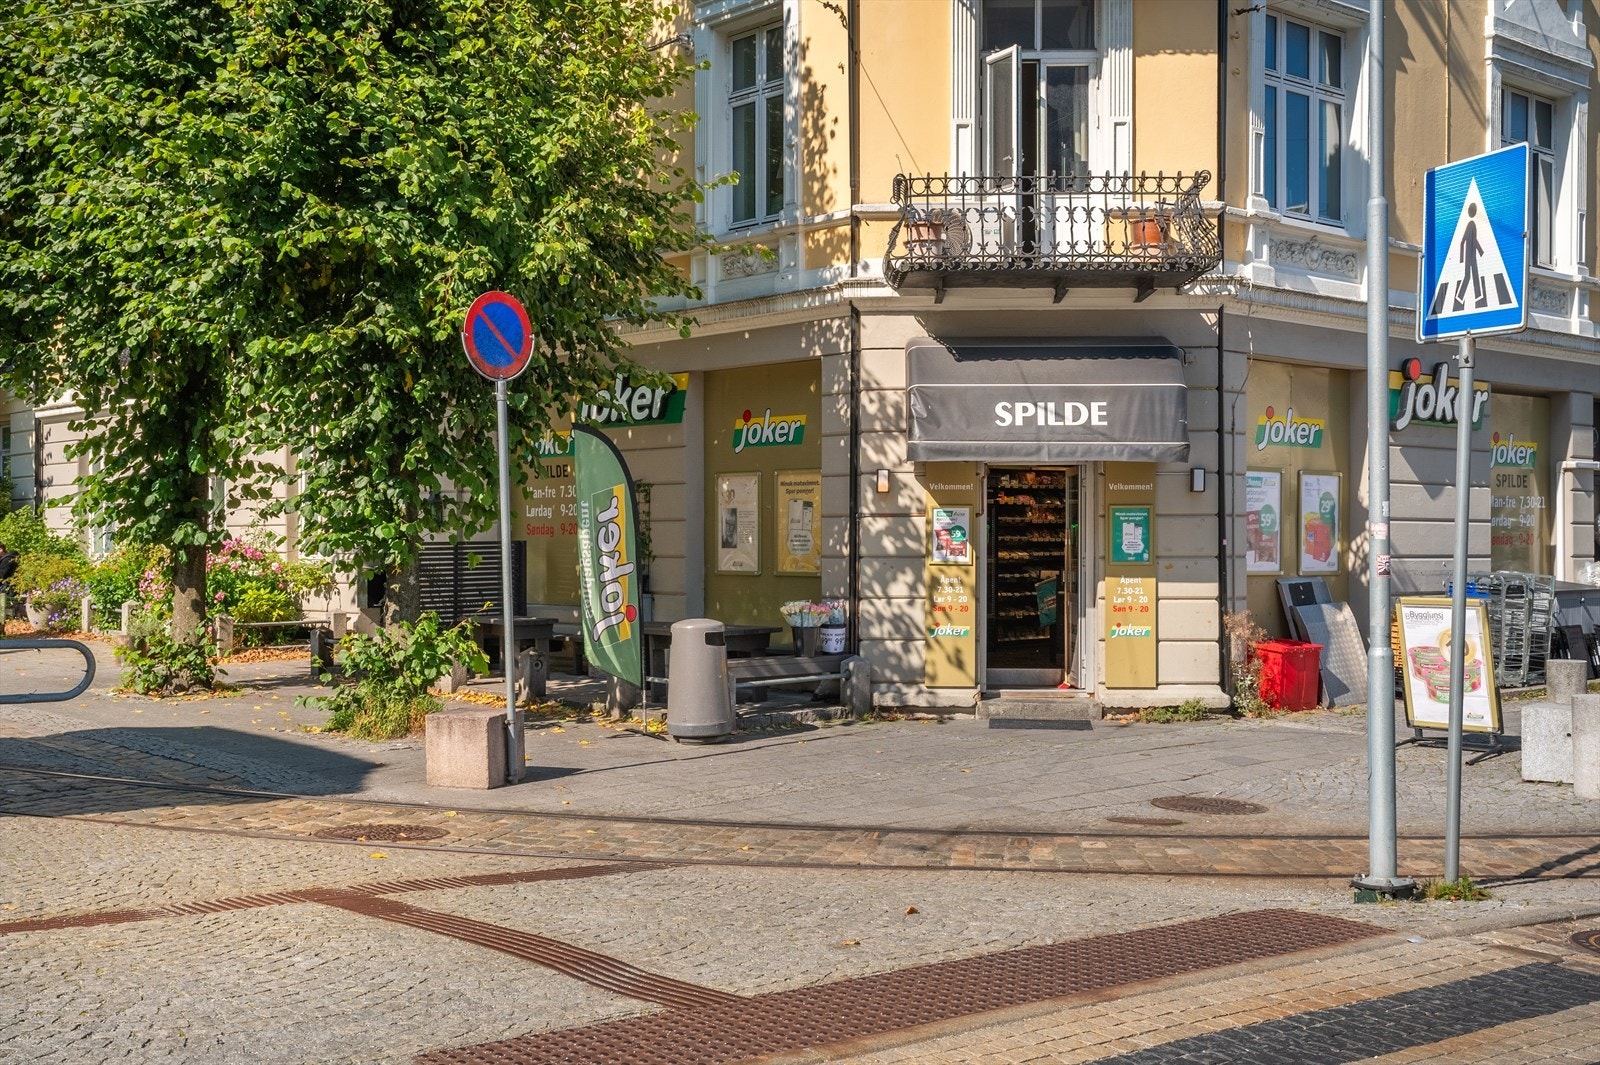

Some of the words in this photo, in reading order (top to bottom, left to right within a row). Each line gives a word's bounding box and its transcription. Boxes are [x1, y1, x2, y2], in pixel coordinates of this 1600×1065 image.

[1396, 357, 1489, 431] jokr
[994, 401, 1108, 427] SPILDE
[734, 408, 801, 454] joker
[1257, 405, 1321, 452] joker
[1491, 431, 1535, 469] joker
[534, 464, 569, 479] SILDE
[929, 483, 974, 491] Velkommen!
[1108, 483, 1153, 491] Velkommen!
[1496, 474, 1528, 489] SPILDE
[526, 485, 556, 499] an-fre
[1519, 496, 1545, 509] 7.30-21
[526, 504, 553, 519] Lørdag
[1491, 514, 1512, 529] ørdag
[1519, 514, 1535, 527] 9-20
[526, 523, 555, 538] Søndag
[560, 522, 578, 535] 9-20
[1491, 533, 1513, 547] øndag
[1518, 532, 1534, 546] 9-20
[940, 574, 961, 585] Åpent
[1120, 575, 1142, 585] Åpent
[937, 586, 964, 594] 7.30-21
[1116, 587, 1144, 595] 7.30-21
[933, 595, 946, 603] Lør
[946, 595, 952, 603] 9
[958, 595, 968, 603] 20
[933, 604, 946, 612] Søn
[948, 604, 953, 612] 9
[930, 622, 967, 638] joker
[1111, 622, 1149, 639] joker
